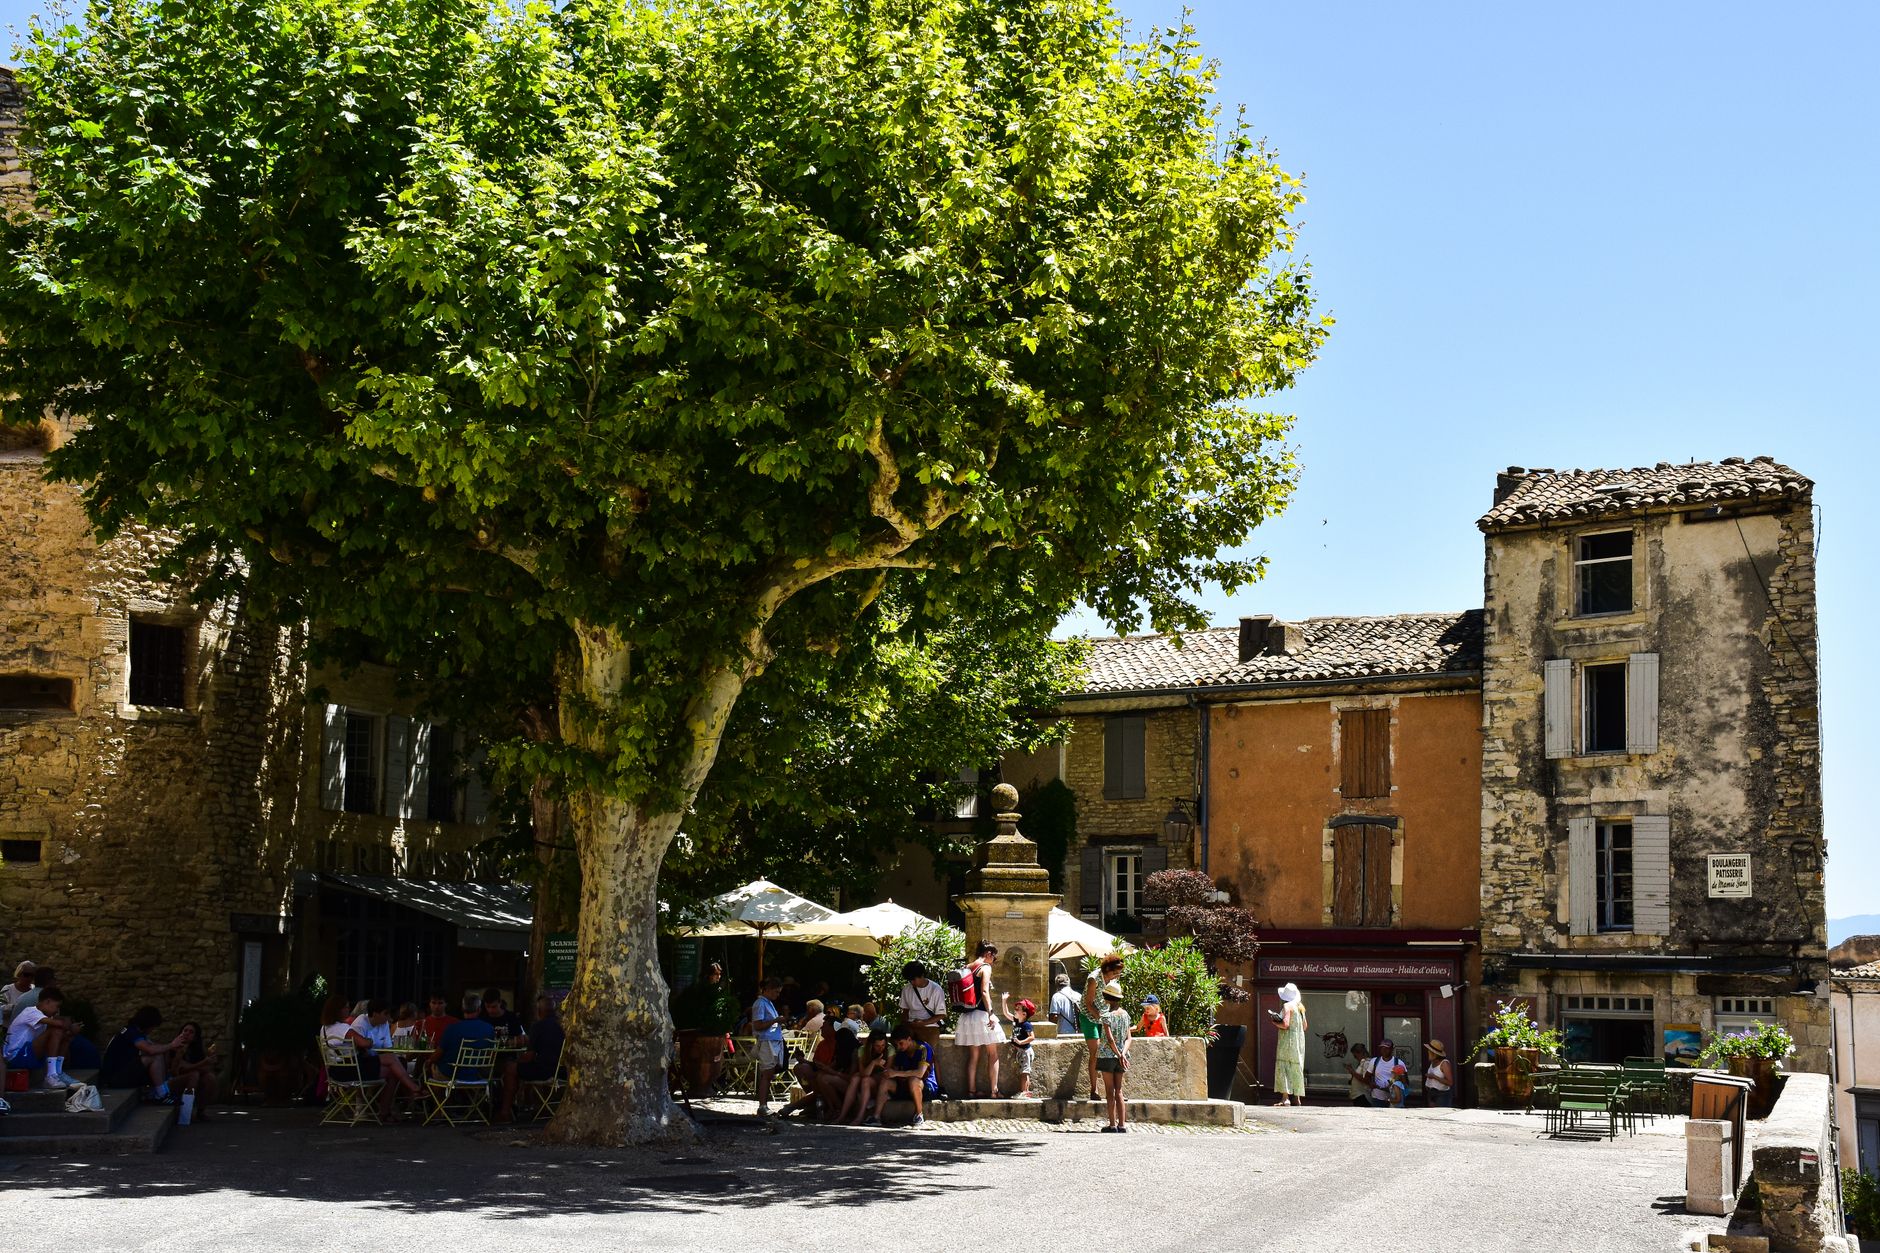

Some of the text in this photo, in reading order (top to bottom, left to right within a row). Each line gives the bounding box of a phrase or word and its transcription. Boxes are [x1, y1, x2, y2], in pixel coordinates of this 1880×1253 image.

[1712, 859, 1746, 868] BOULANGERIE
[1716, 870, 1743, 878] PATISSERIE
[1718, 879, 1735, 889] Mamie
[1269, 963, 1298, 972] Lavande
[1302, 964, 1319, 972] Miel
[1323, 964, 1348, 973] Savons
[1353, 965, 1394, 974] artisanaux
[1398, 965, 1418, 974] Huile
[1418, 965, 1447, 975] d'olives
